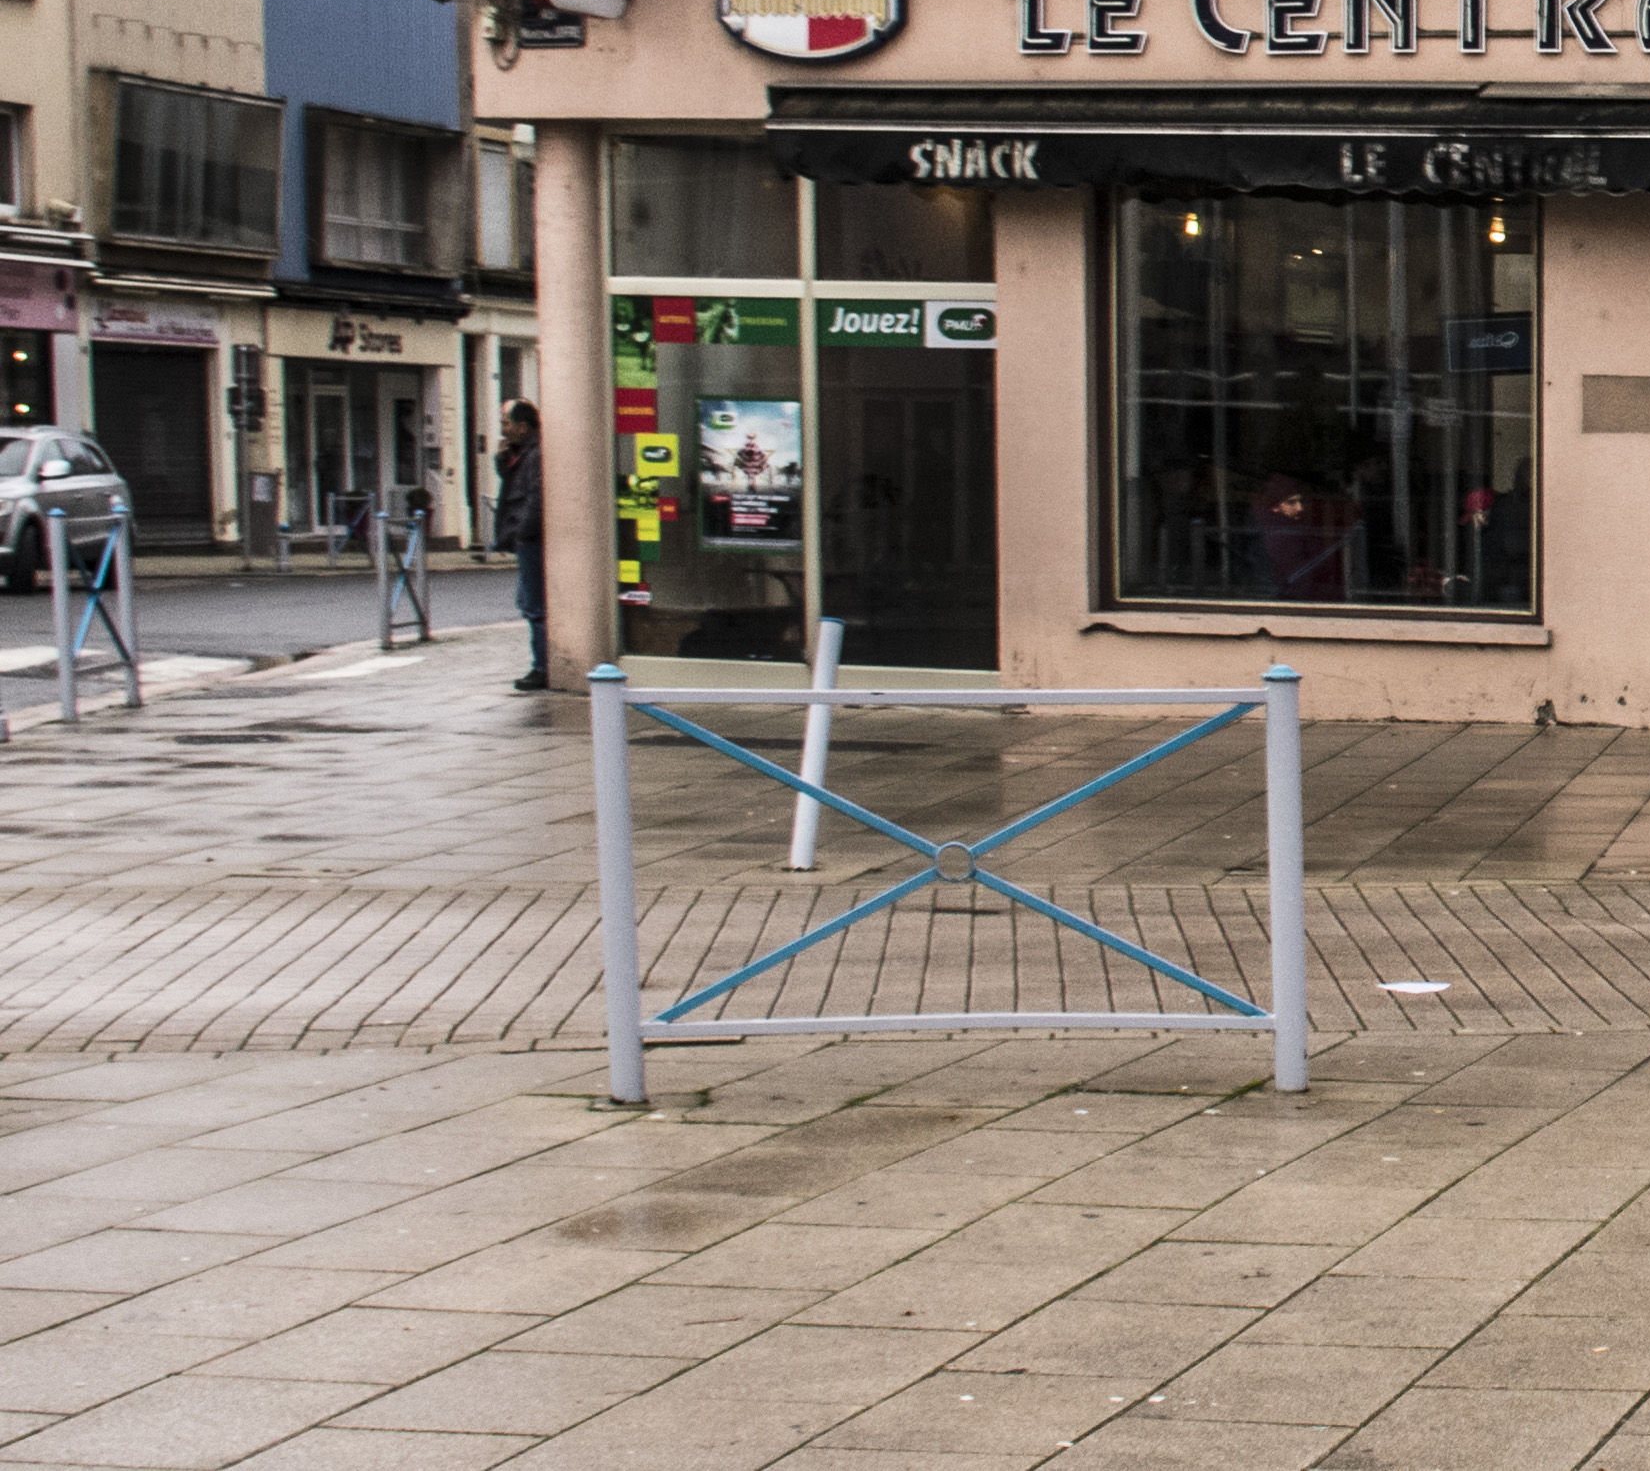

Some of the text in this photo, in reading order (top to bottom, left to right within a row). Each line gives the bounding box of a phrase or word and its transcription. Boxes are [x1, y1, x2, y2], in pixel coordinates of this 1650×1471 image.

[909, 139, 1040, 180] SNACK
[1339, 142, 1387, 184] LE
[828, 306, 921, 334] Jouez!
[942, 318, 980, 332] PMU
